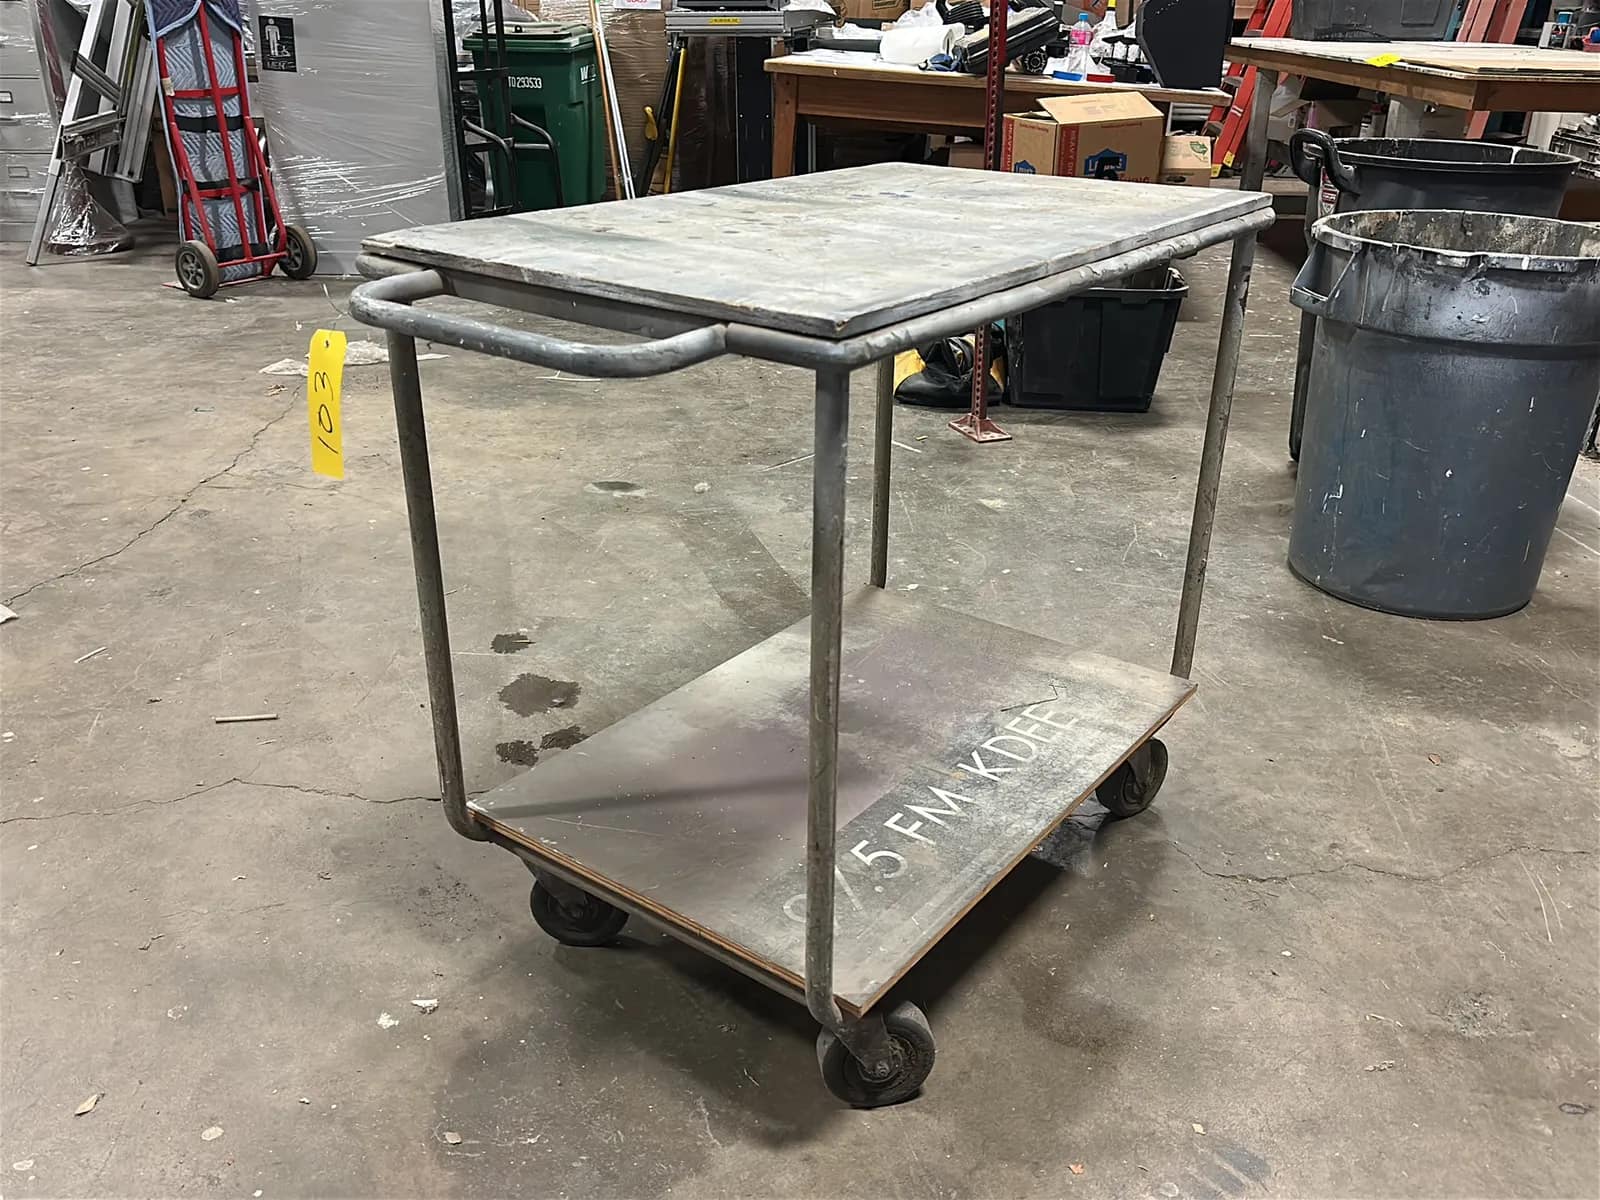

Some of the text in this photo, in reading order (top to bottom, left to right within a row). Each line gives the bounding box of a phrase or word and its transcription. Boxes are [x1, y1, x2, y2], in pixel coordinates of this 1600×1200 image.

[314, 371, 339, 454] 103
[883, 785, 984, 846] FM
[956, 704, 1079, 783] KDEE
